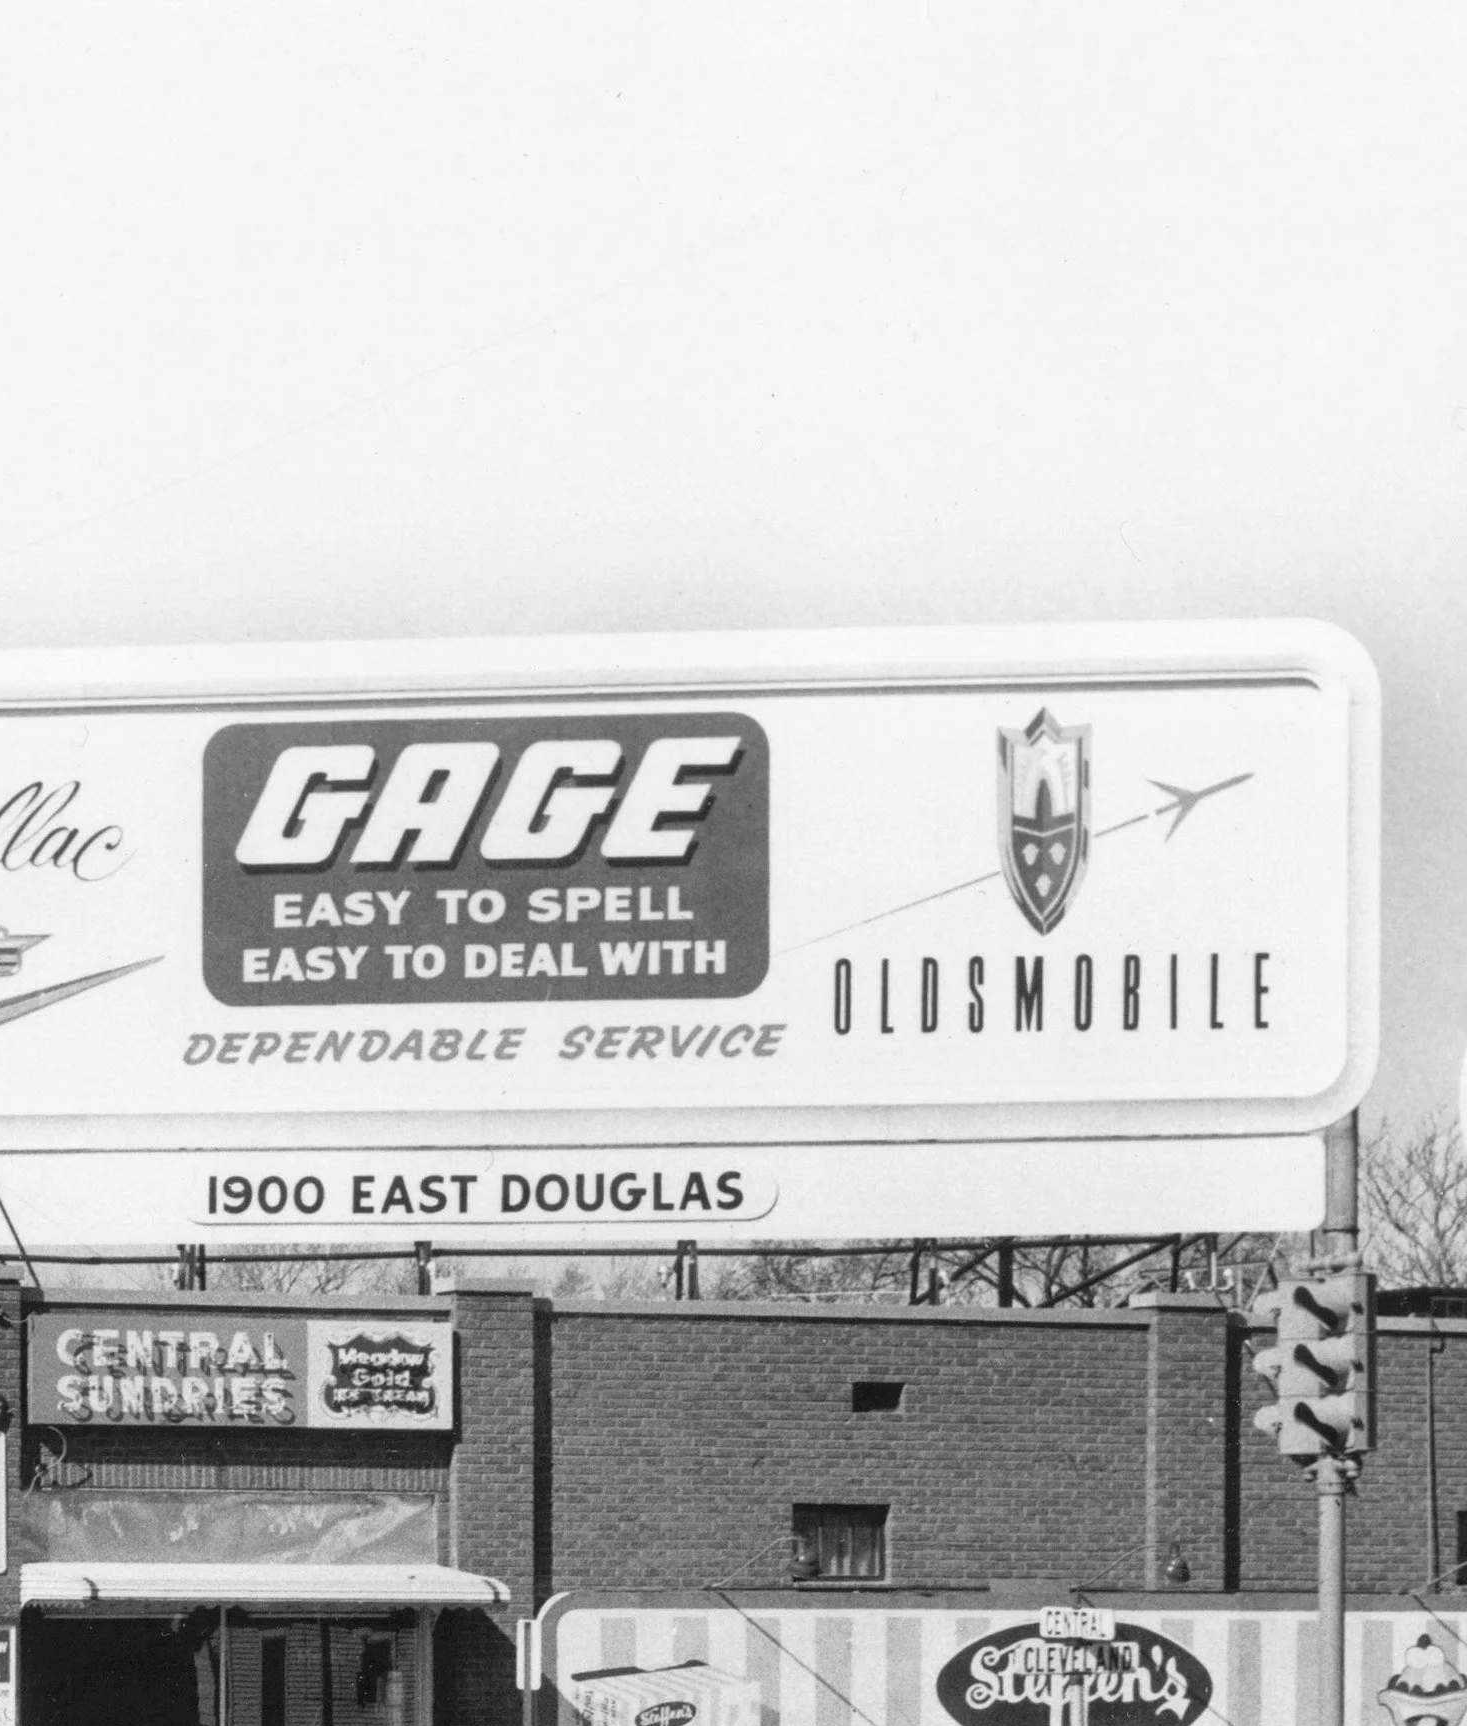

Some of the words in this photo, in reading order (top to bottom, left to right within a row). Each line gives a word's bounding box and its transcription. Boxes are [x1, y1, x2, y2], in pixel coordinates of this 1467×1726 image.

[234, 736, 743, 872] GAGE
[273, 890, 411, 930] EASY
[435, 887, 505, 926] TO
[527, 885, 694, 924] SPELL
[242, 947, 363, 984] EASY
[384, 944, 447, 981] TO
[467, 942, 588, 980] DEAL
[598, 939, 727, 977] WITH
[833, 952, 1271, 1036] OLDSMOBILE
[181, 1026, 527, 1068] DEPENDABLE
[557, 1022, 789, 1062] SERVICE
[208, 1174, 326, 1217] 1900
[351, 1172, 479, 1215] EAST
[500, 1169, 746, 1214] DOUGLAS
[56, 1328, 288, 1370] CENTRAL
[337, 1347, 425, 1366] Meadow
[56, 1374, 288, 1416] SUNDRIES
[351, 1368, 411, 1387] Gold
[1045, 1609, 1106, 1638] CENTRAL
[1023, 1642, 1135, 1673] CLEVELAND
